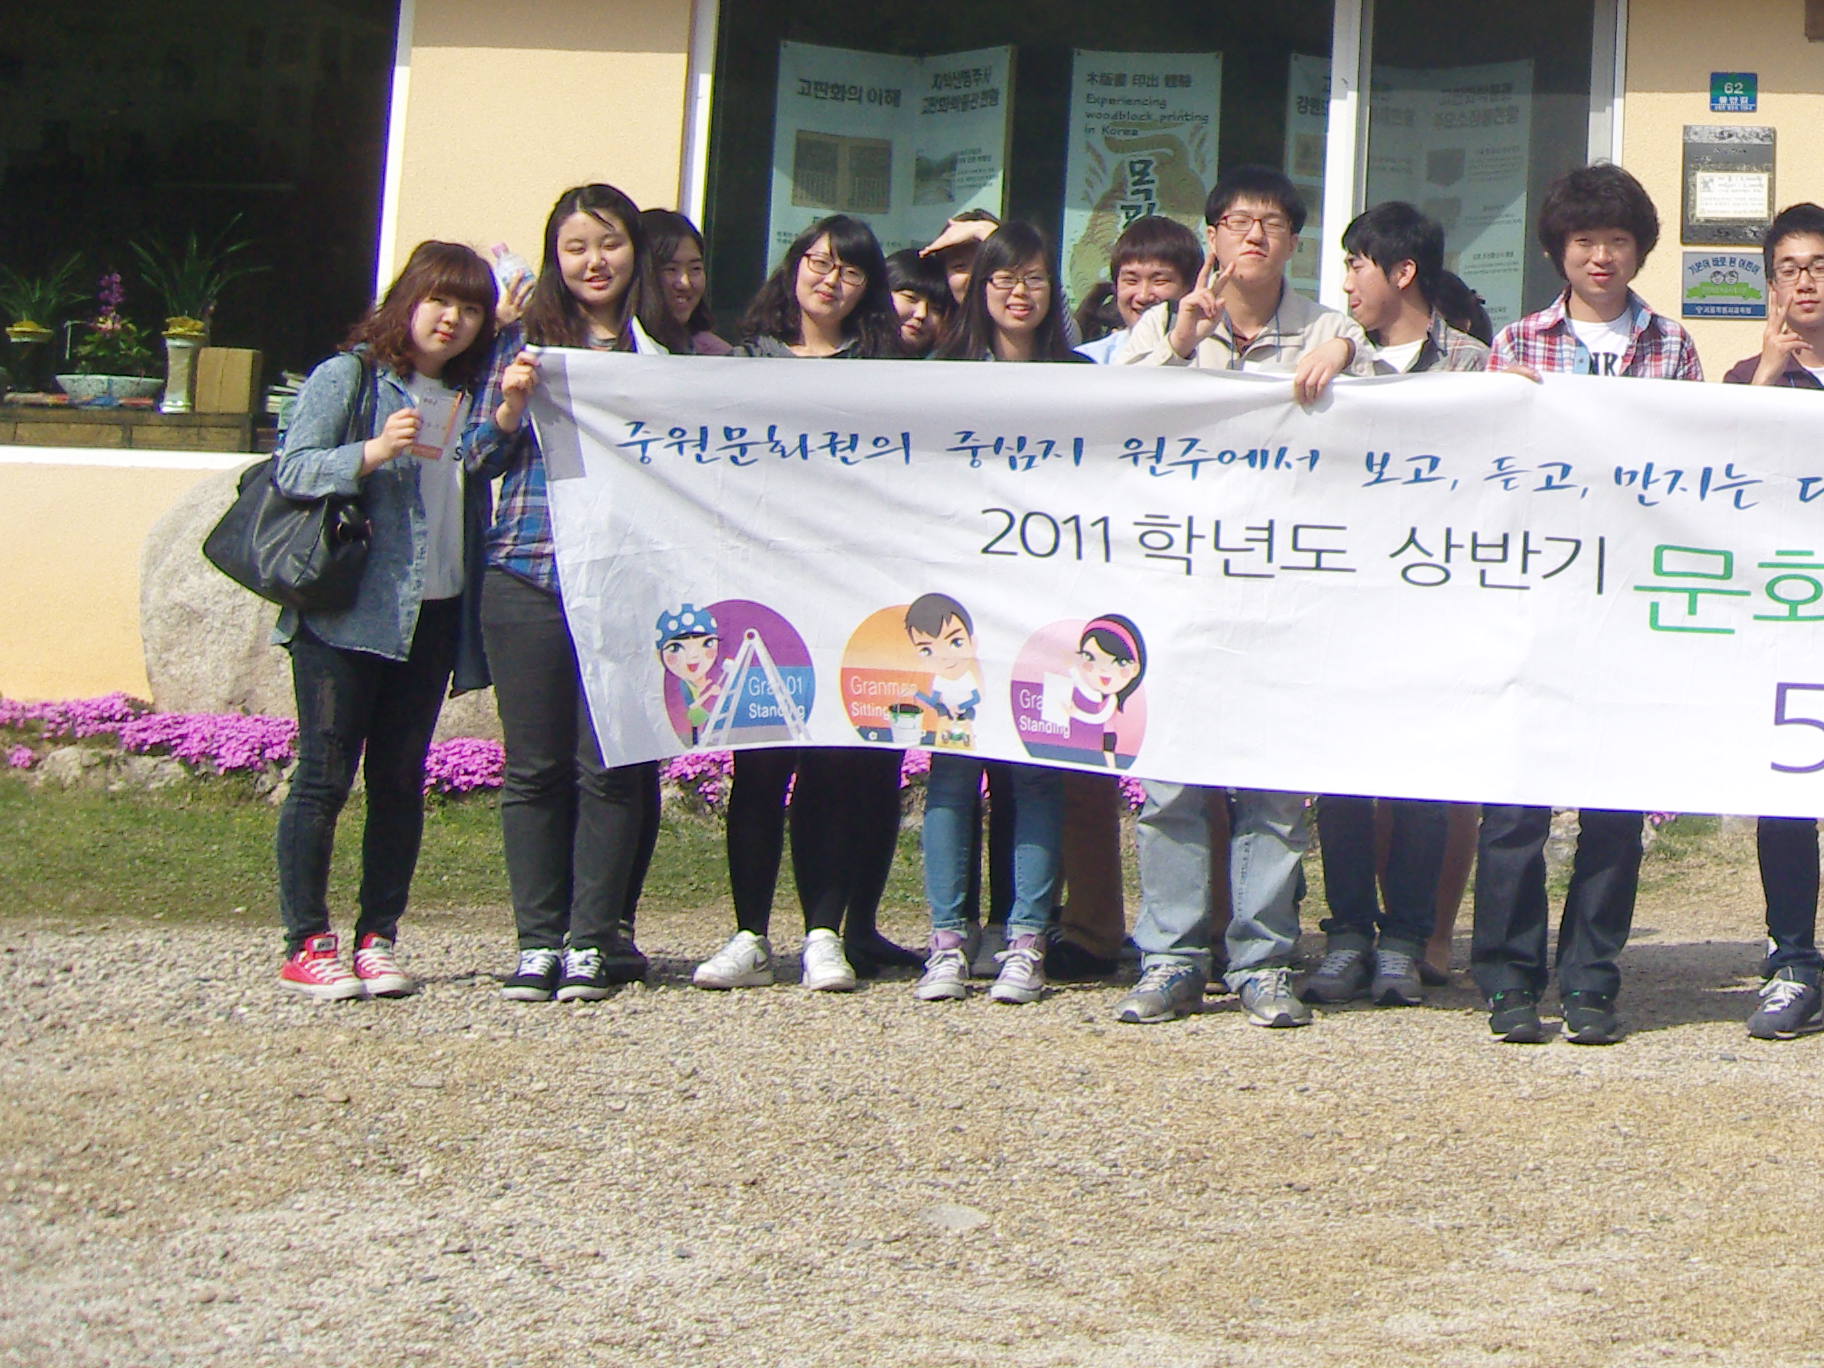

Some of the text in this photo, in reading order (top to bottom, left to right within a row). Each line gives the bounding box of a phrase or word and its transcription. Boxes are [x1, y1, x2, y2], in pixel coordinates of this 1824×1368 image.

[796, 78, 902, 108] 고판화의 이해
[1723, 82, 1744, 95] 62
[1085, 92, 1168, 109] Experiencing
[1084, 110, 1209, 125] woodblock printing
[1102, 124, 1139, 136] Korea
[616, 420, 912, 468] 중원문화권의
[947, 431, 1083, 470] 중심지
[1118, 436, 1320, 481] 원주에서
[1364, 450, 1461, 493] 보고,
[1612, 461, 1762, 510] 만지는
[980, 507, 1113, 564] 2011
[1133, 514, 1357, 580] 학년도
[1388, 526, 1608, 597] 상반기
[850, 700, 892, 721] Sitting
[1018, 715, 1071, 739] Standing
